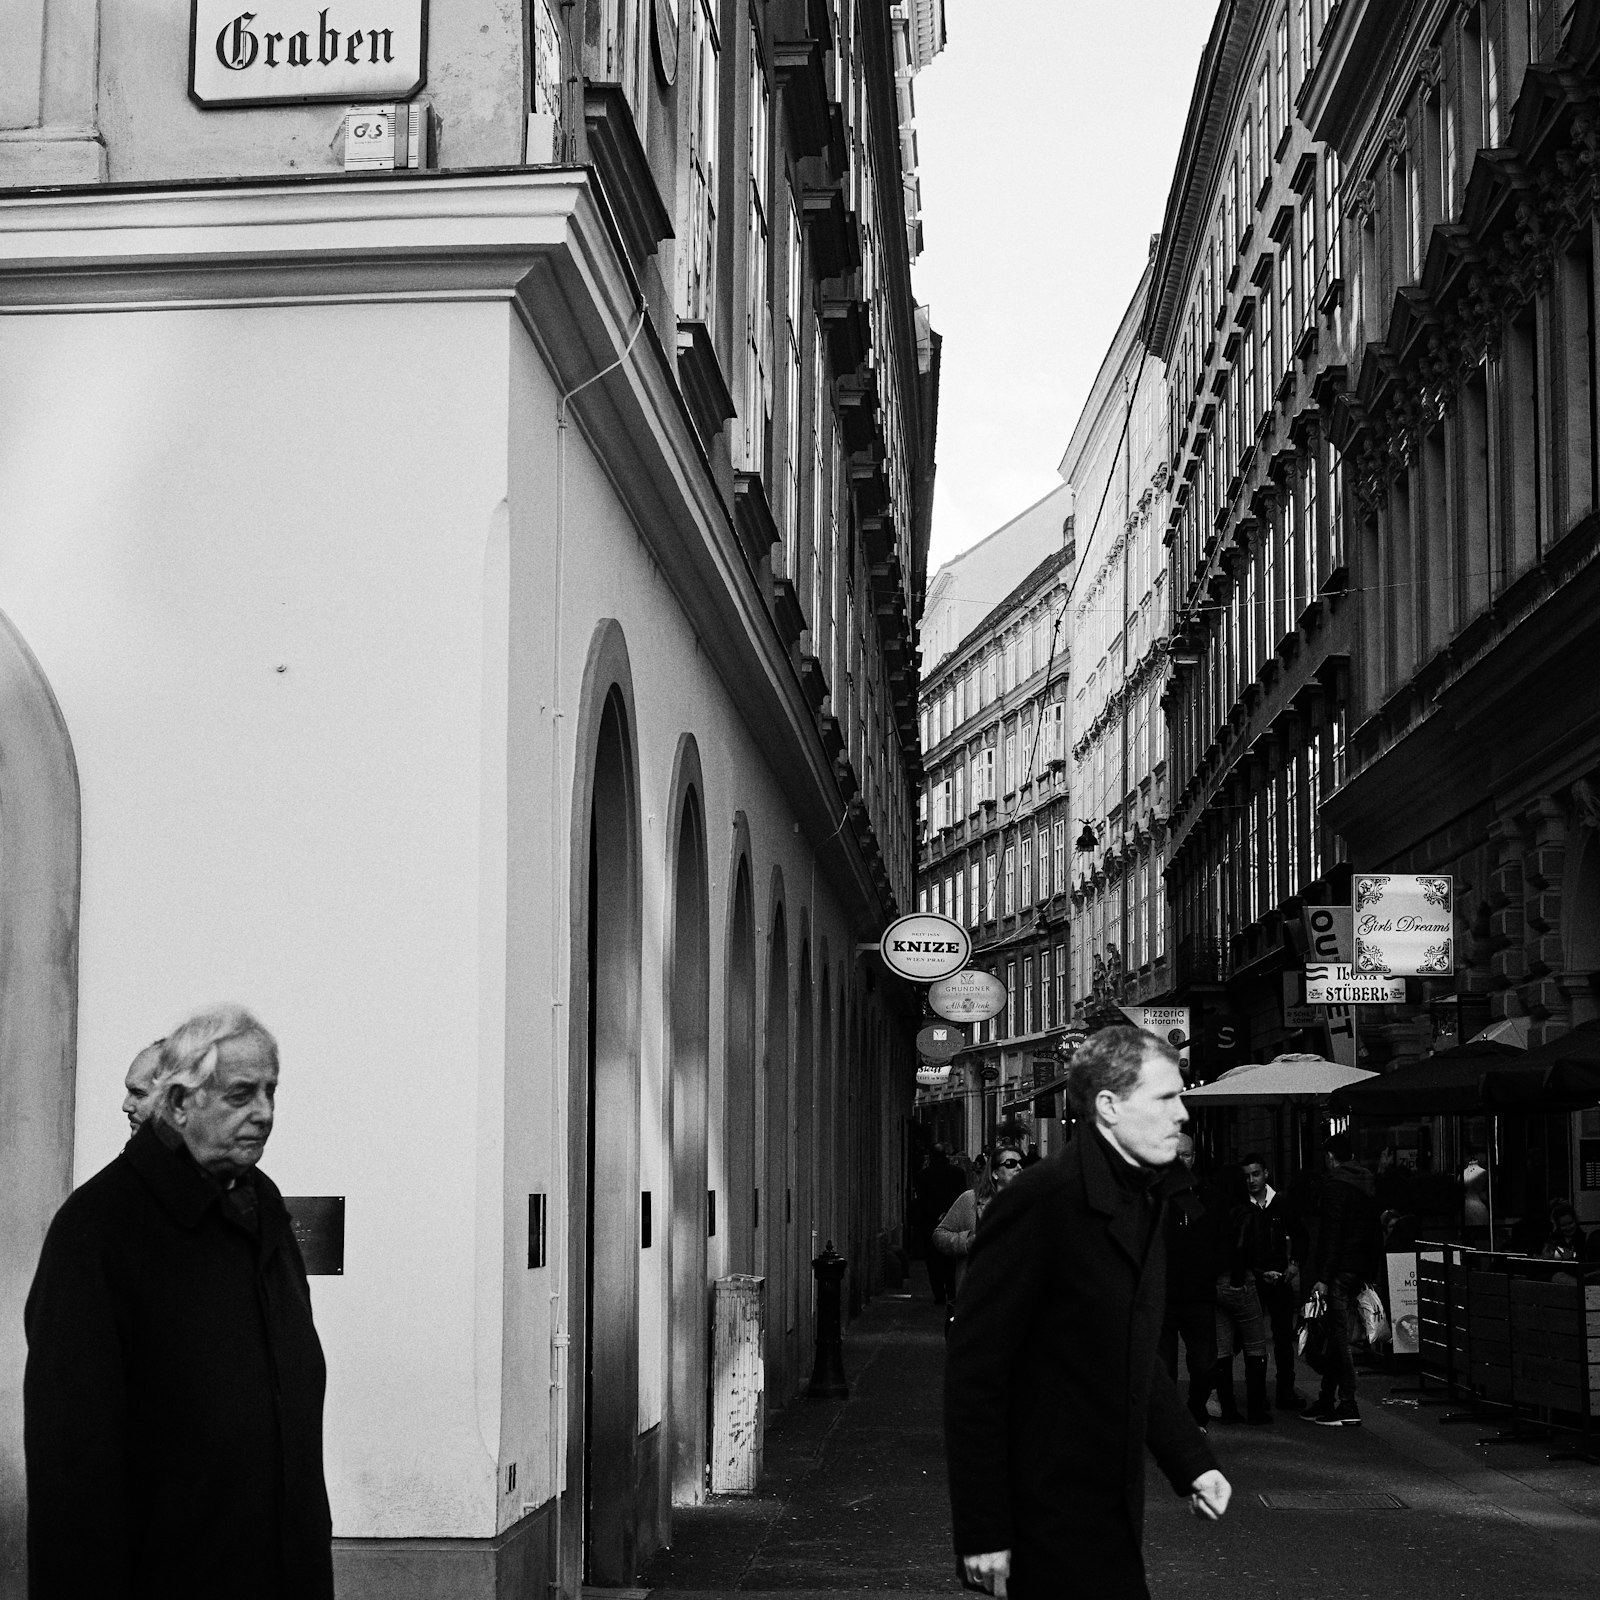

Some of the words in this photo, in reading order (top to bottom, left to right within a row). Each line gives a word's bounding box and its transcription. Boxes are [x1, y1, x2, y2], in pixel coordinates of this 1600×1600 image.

[216, 7, 395, 70] Graben
[1357, 914, 1393, 936] Girls
[1395, 915, 1450, 932] Dreams
[892, 940, 960, 954] KNIZE
[1326, 983, 1389, 1002] STÜBERL
[1143, 1008, 1184, 1018] Pizzeria
